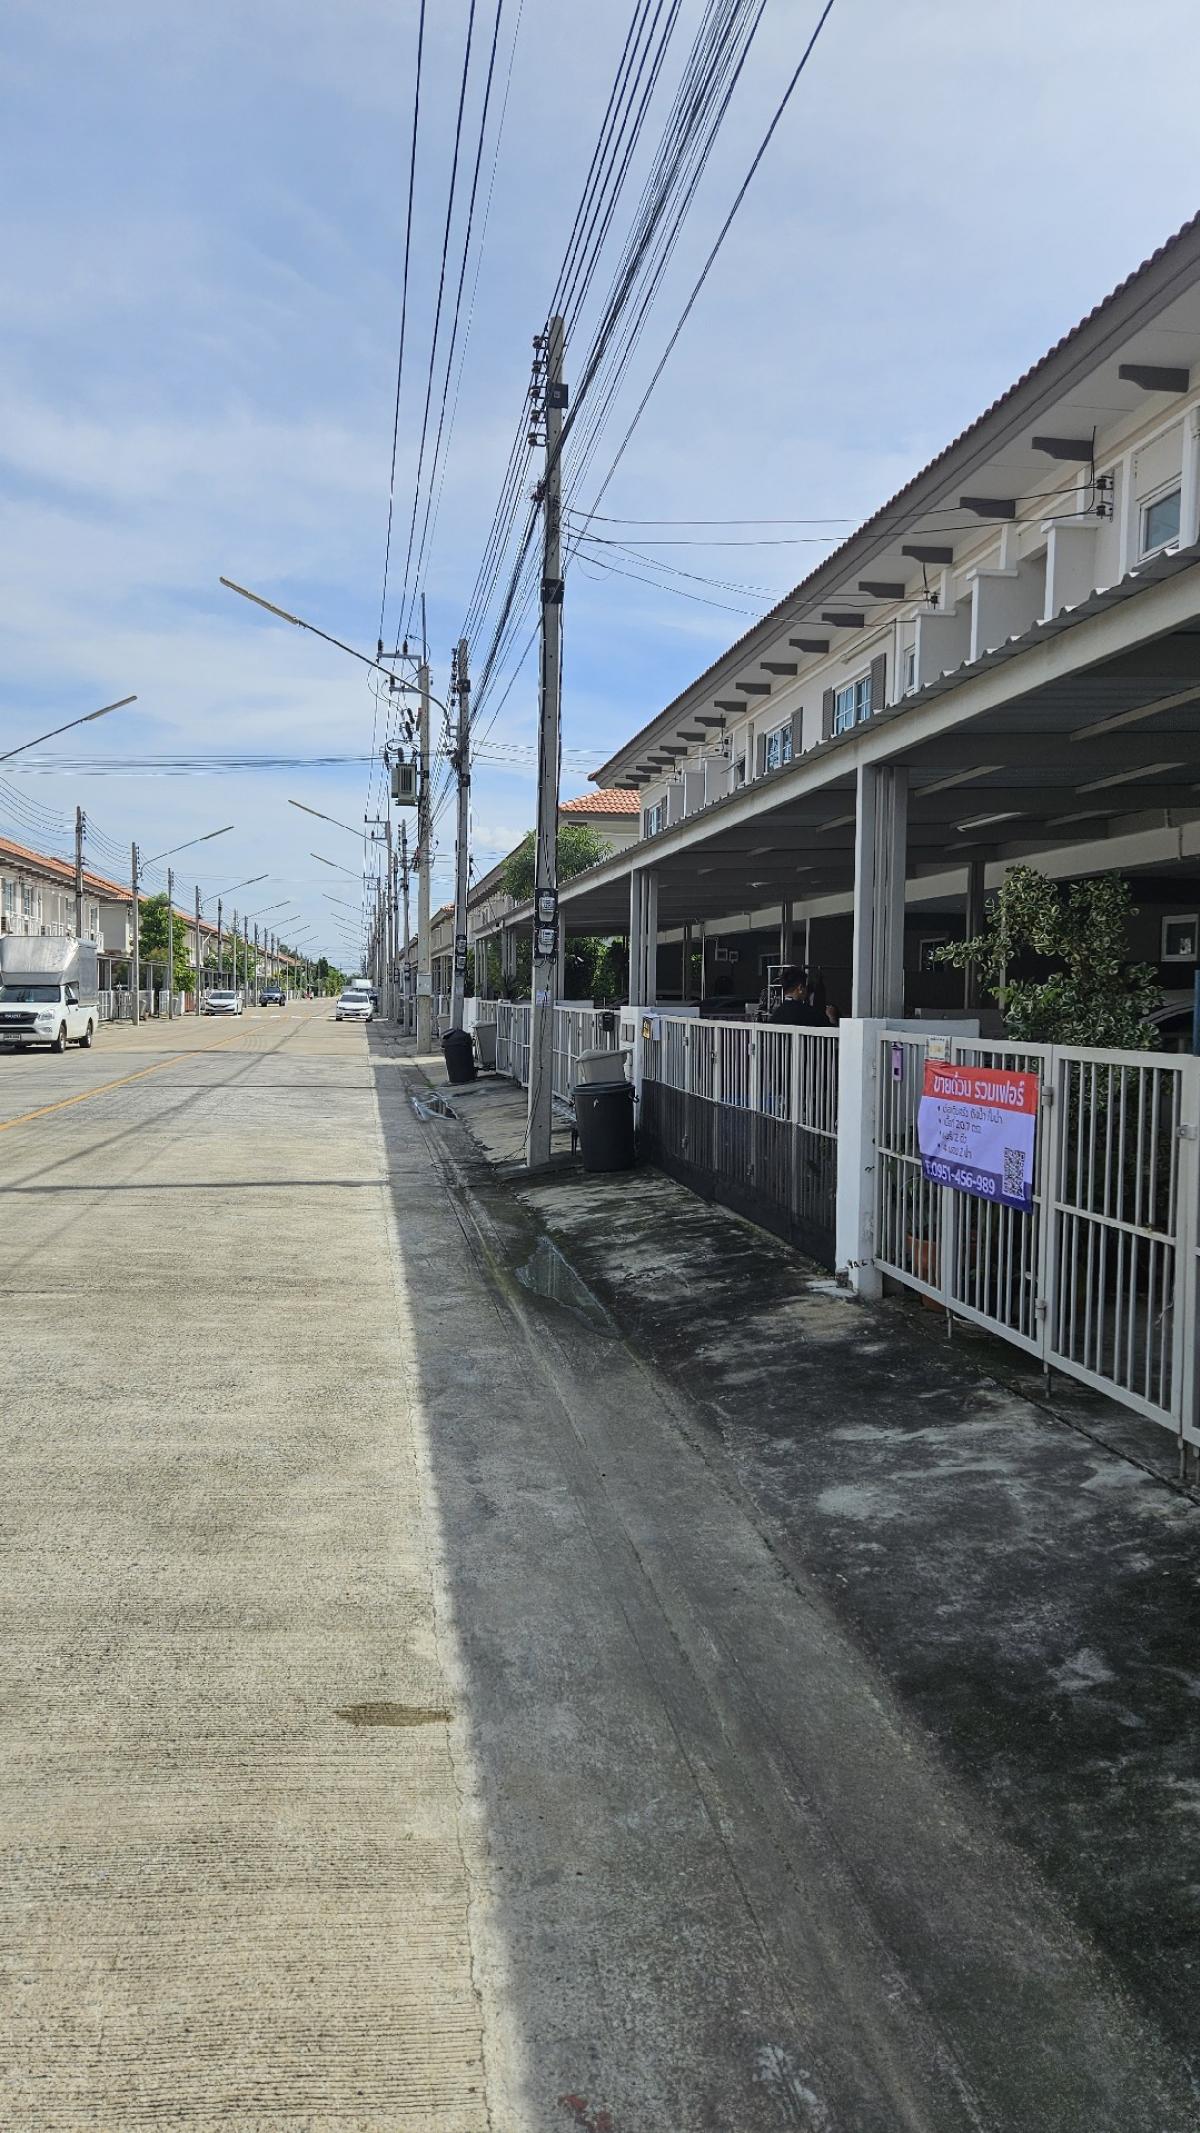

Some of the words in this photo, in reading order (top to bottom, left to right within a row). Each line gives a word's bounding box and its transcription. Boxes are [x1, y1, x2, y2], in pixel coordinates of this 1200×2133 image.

[933, 1071, 972, 1098] ขายด่วน
[974, 1080, 1025, 1107] รวมเฟอร์
